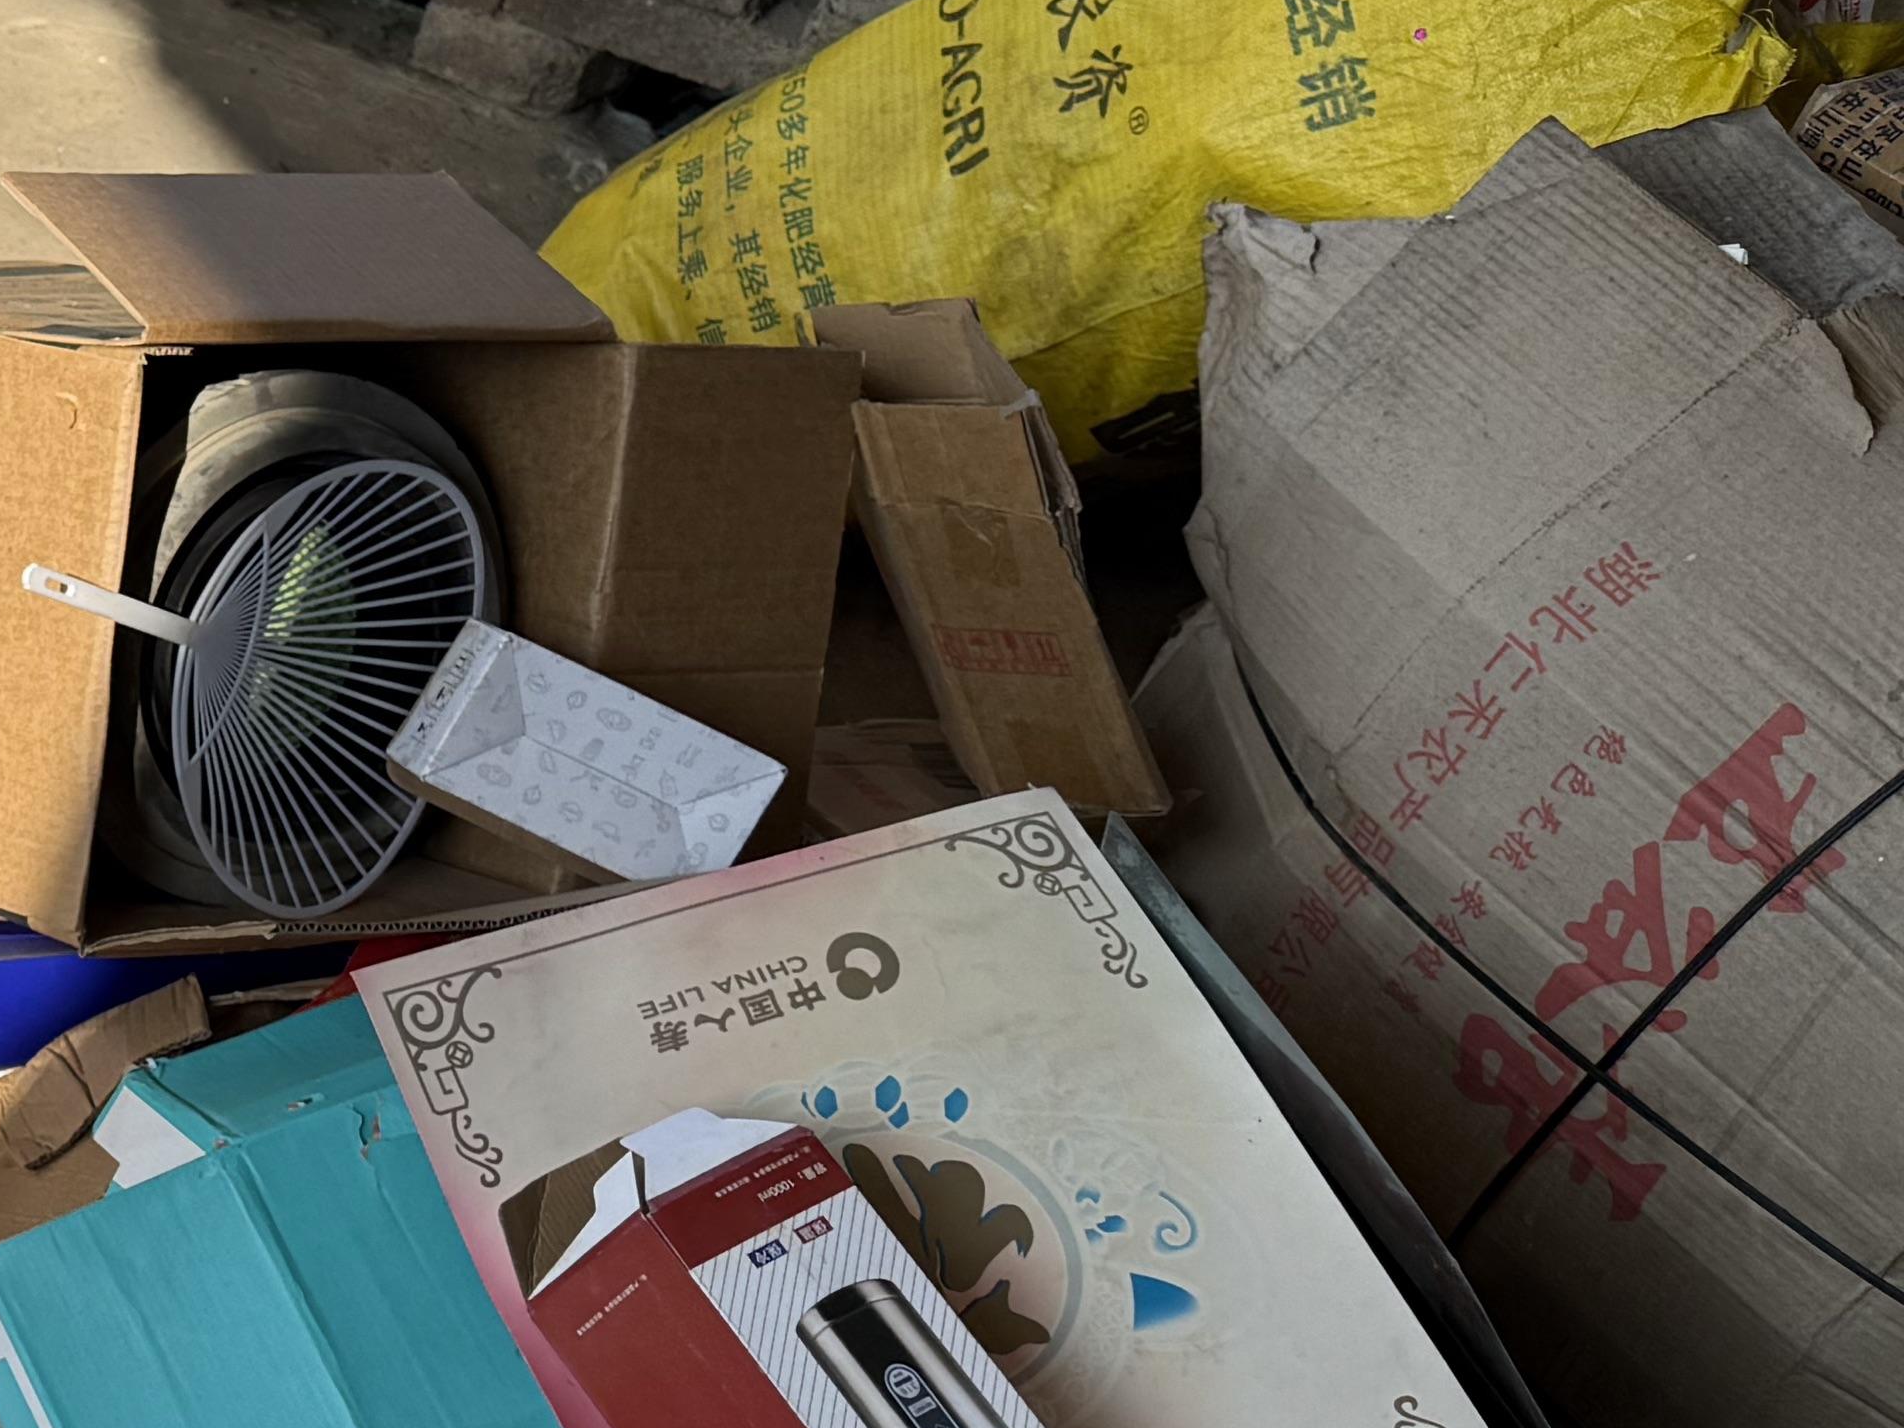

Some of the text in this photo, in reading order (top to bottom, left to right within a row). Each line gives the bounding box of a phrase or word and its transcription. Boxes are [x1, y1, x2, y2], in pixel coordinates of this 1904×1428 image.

[775, 62, 839, 310] 50多年化肥经营
[636, 953, 809, 1021] CHINA LIFE
[649, 976, 827, 1053] 中国人寿
